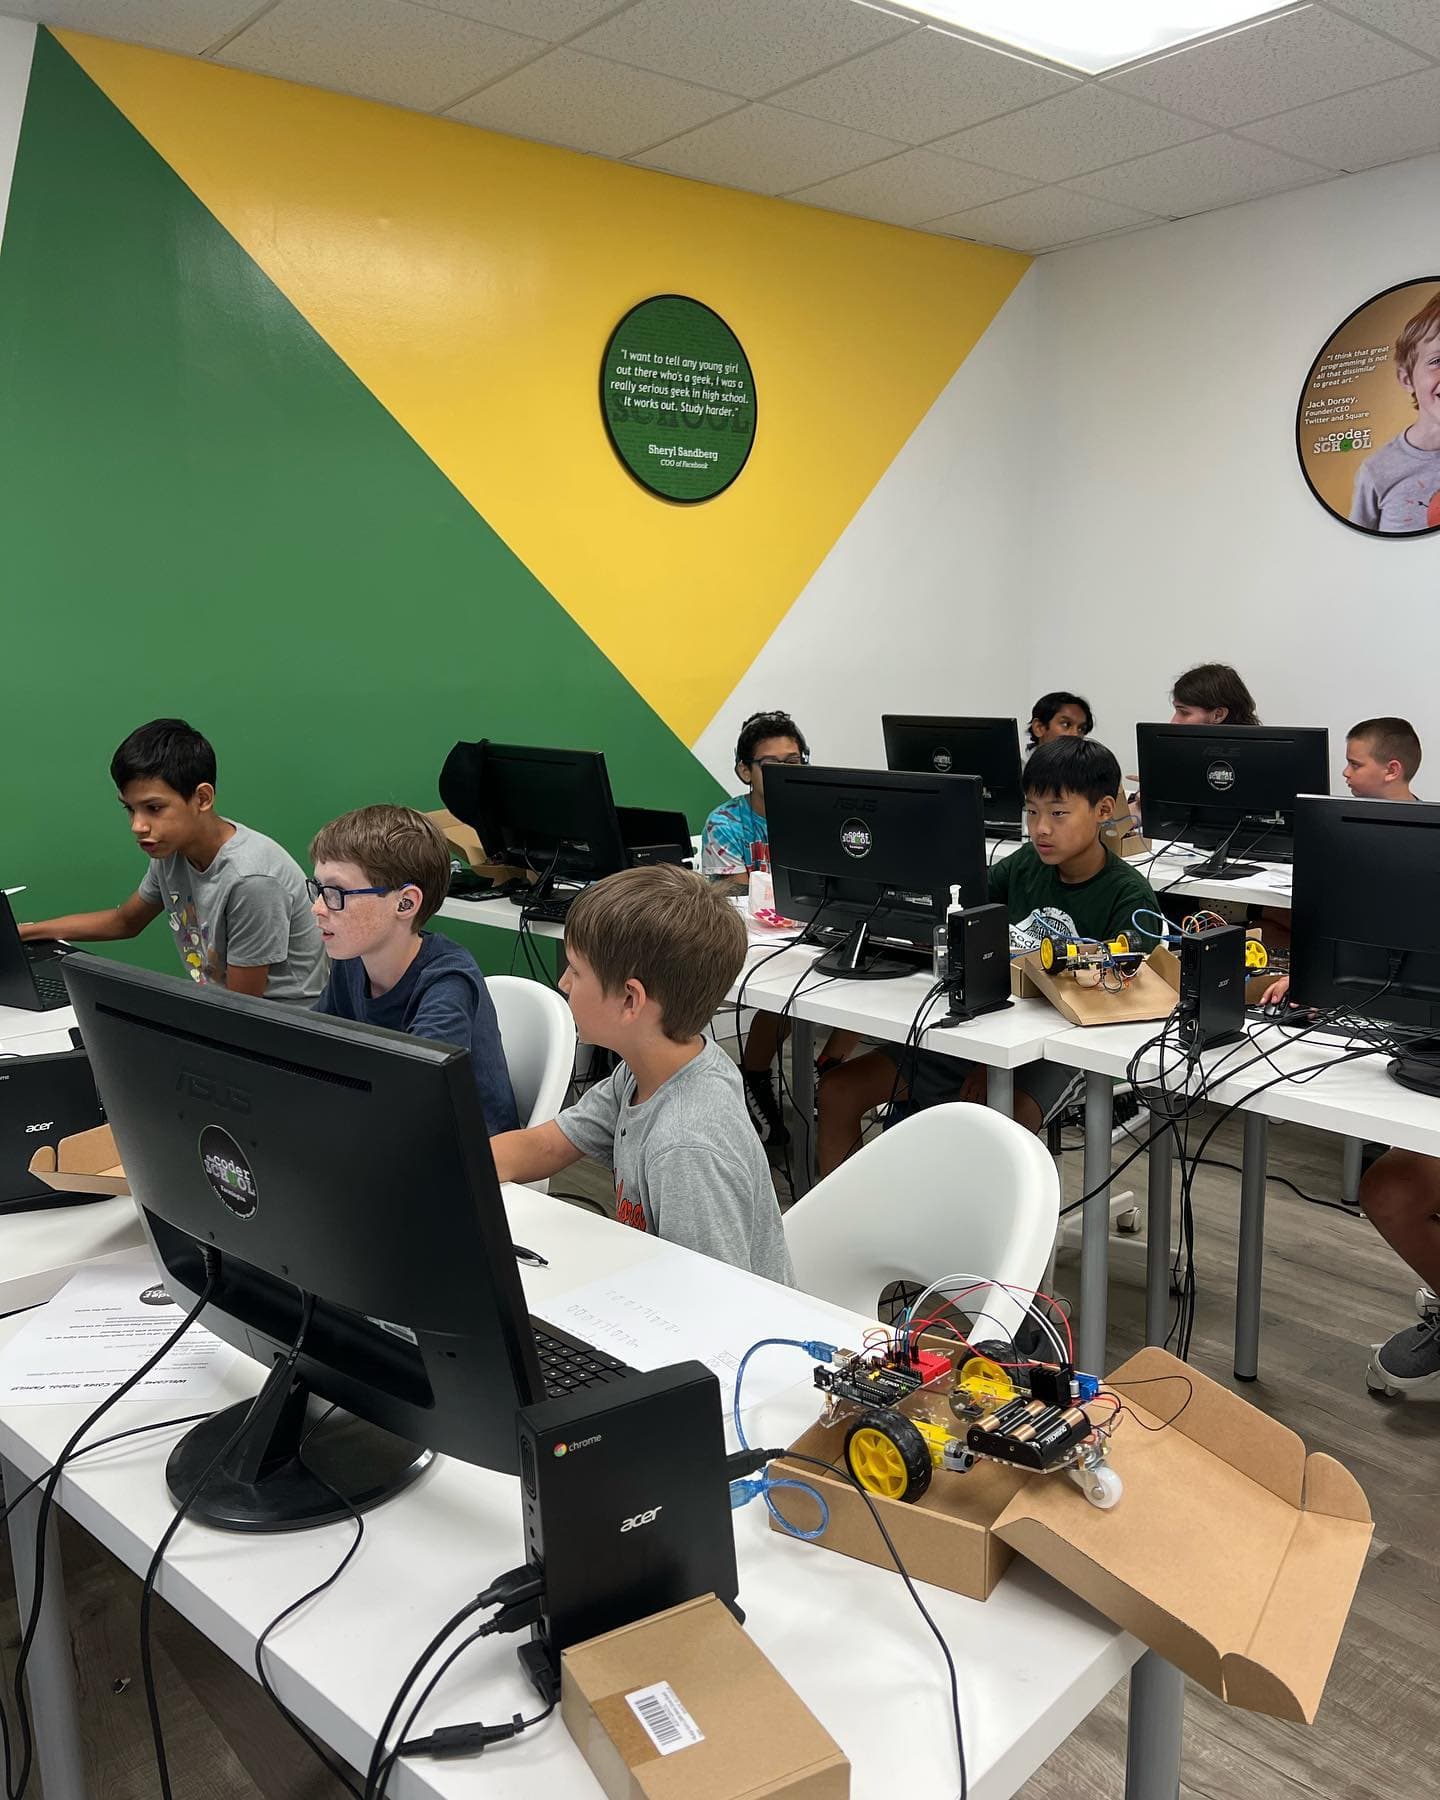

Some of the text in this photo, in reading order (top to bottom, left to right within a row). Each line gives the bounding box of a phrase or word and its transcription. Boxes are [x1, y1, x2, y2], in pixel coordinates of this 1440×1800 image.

[1334, 351, 1353, 361] think
[1354, 349, 1369, 357] that
[1370, 345, 1390, 355] great
[629, 352, 651, 363] want
[653, 354, 664, 364] to
[665, 355, 680, 366] tell
[682, 359, 698, 371] any
[699, 361, 723, 374] young
[724, 362, 739, 375] girl
[1320, 358, 1367, 372] programming
[616, 366, 744, 389] out there who's a geek, I was a
[1316, 365, 1376, 380] all that dissimilar
[610, 380, 749, 404] really serious geek in high school.
[1321, 379, 1340, 389] great
[623, 396, 632, 407] It
[633, 398, 659, 409] works
[660, 401, 679, 412] out.
[680, 401, 705, 416] Study
[1307, 396, 1359, 409] Jack Dorsey,
[1304, 417, 1330, 425] Twitter
[1345, 412, 1370, 420] Square
[1305, 405, 1350, 417] Founder/CEO
[1328, 428, 1371, 441] coder
[648, 444, 719, 462] Sheryl Sandberg
[25, 1121, 54, 1133] acer
[213, 1155, 251, 1180] coder
[568, 1434, 602, 1452] chrome
[620, 1506, 662, 1532] acer
